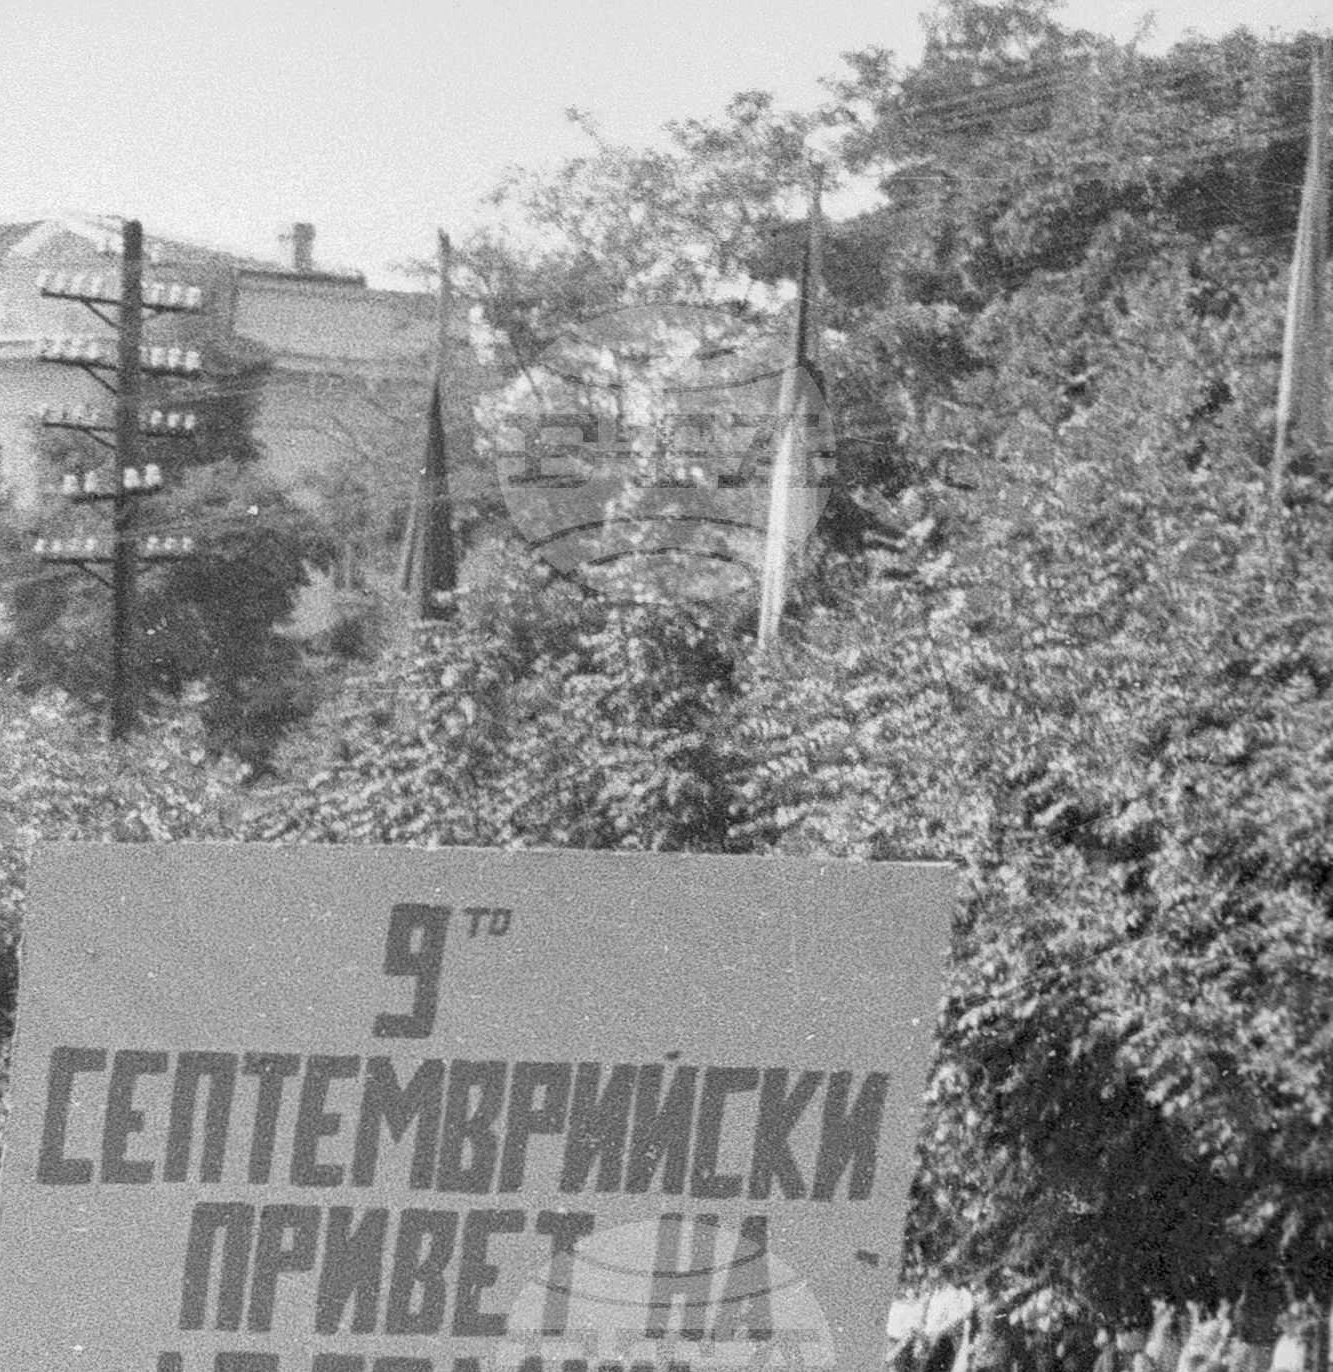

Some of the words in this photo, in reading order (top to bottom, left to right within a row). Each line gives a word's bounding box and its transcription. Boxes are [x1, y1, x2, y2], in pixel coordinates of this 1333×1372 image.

[38, 1046, 890, 1201] СЕПТЕМВРИЙСКИ
[180, 1203, 594, 1336] ПРИВЕТ
[644, 1212, 774, 1342] НА
